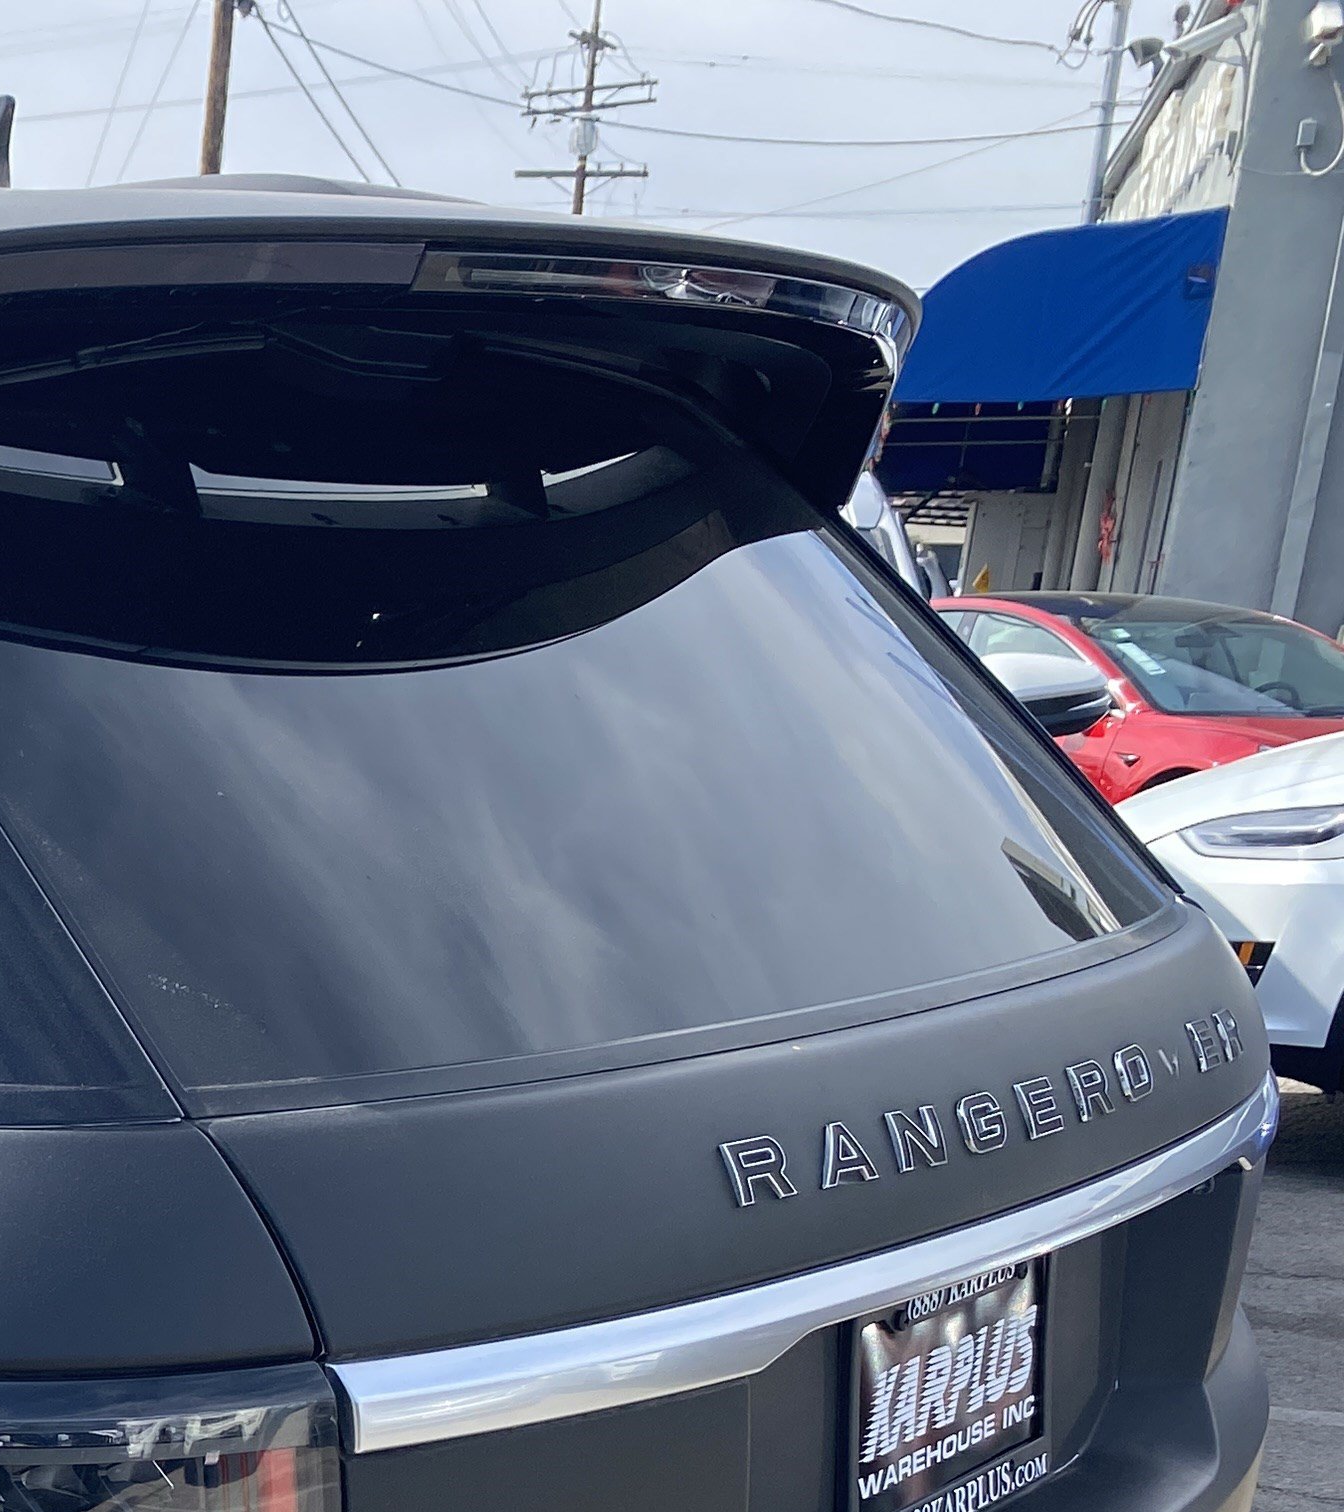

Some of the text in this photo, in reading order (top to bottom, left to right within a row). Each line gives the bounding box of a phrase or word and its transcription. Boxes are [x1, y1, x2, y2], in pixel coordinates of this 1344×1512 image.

[719, 1076, 1064, 1207] RANGE
[858, 1395, 1036, 1500] WAREHOUSE INC
[859, 1304, 1037, 1464] KARPLUS
